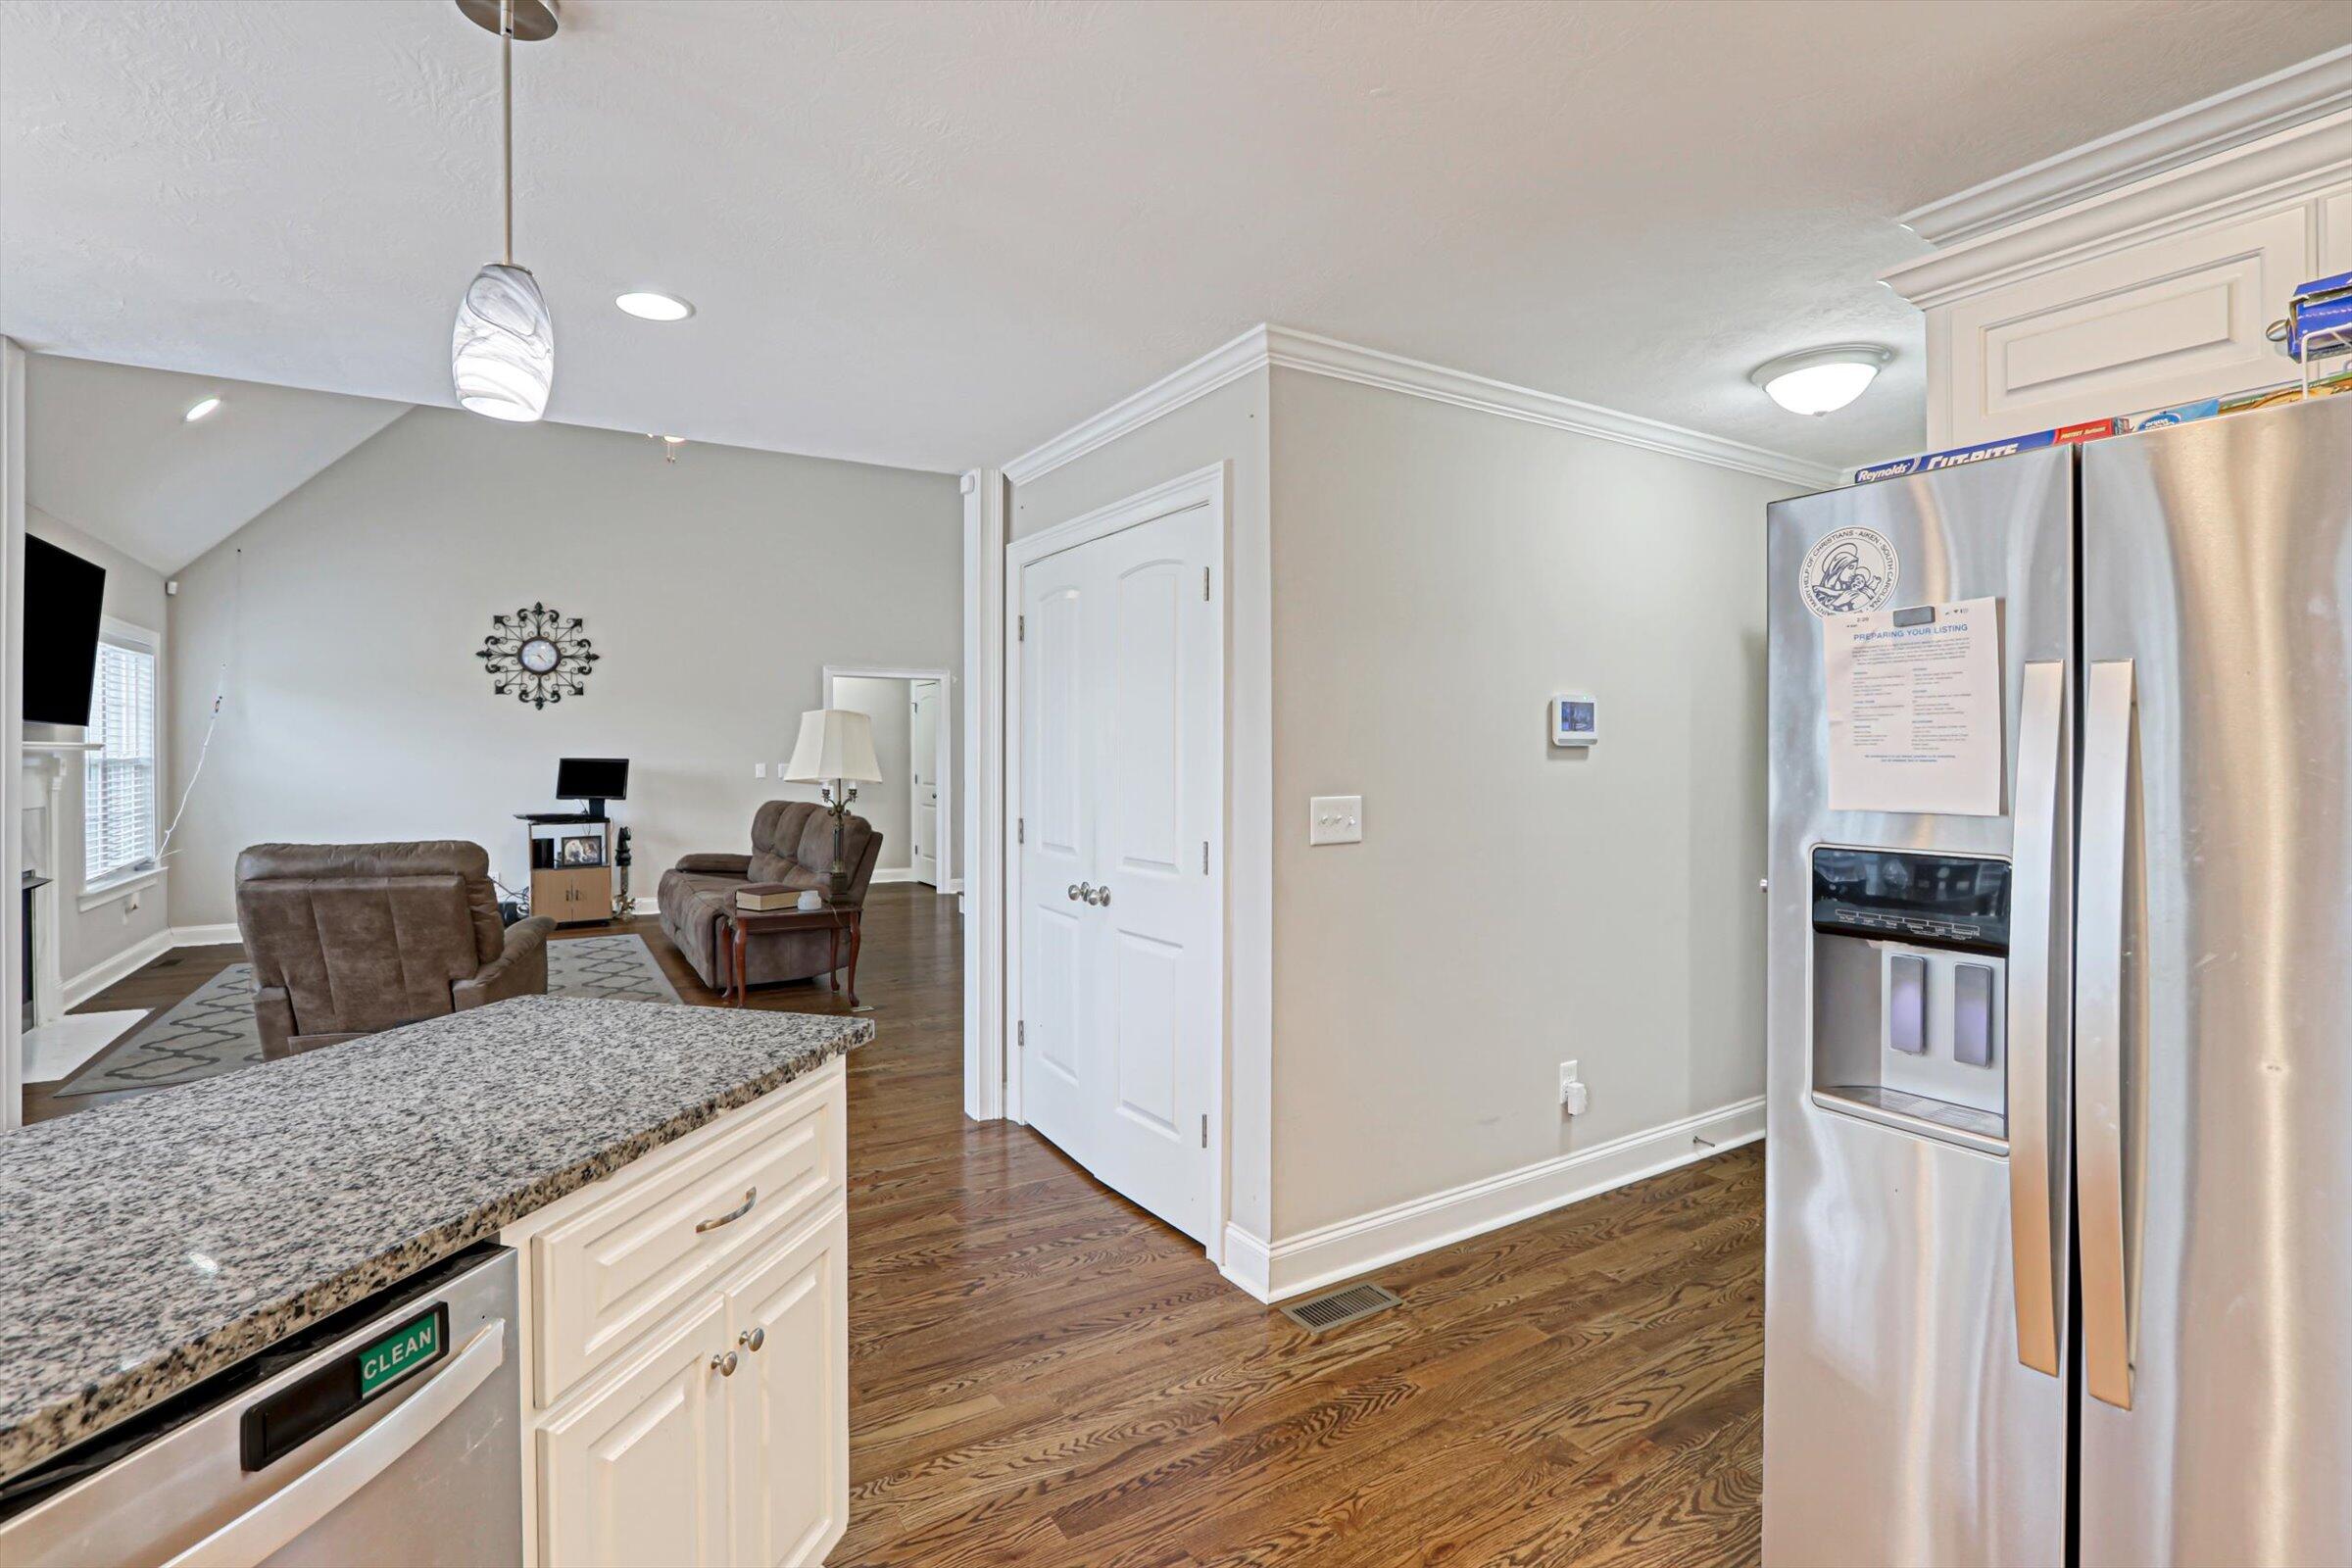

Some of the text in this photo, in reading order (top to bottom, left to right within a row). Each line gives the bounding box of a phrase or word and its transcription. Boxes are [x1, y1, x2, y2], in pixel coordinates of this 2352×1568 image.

[1858, 463, 1907, 482] Reynolds
[1813, 530, 1854, 557] CHRISTIANS
[1858, 530, 1881, 545] AIKEN
[1807, 558, 1815, 568] OF
[1880, 544, 1893, 571] SOUTH
[1805, 590, 1819, 610] MARY
[1869, 571, 1894, 609] CAROLINA
[1853, 623, 1969, 642] PREPARING YOUR LISTING
[363, 1326, 432, 1381] CLEAN
